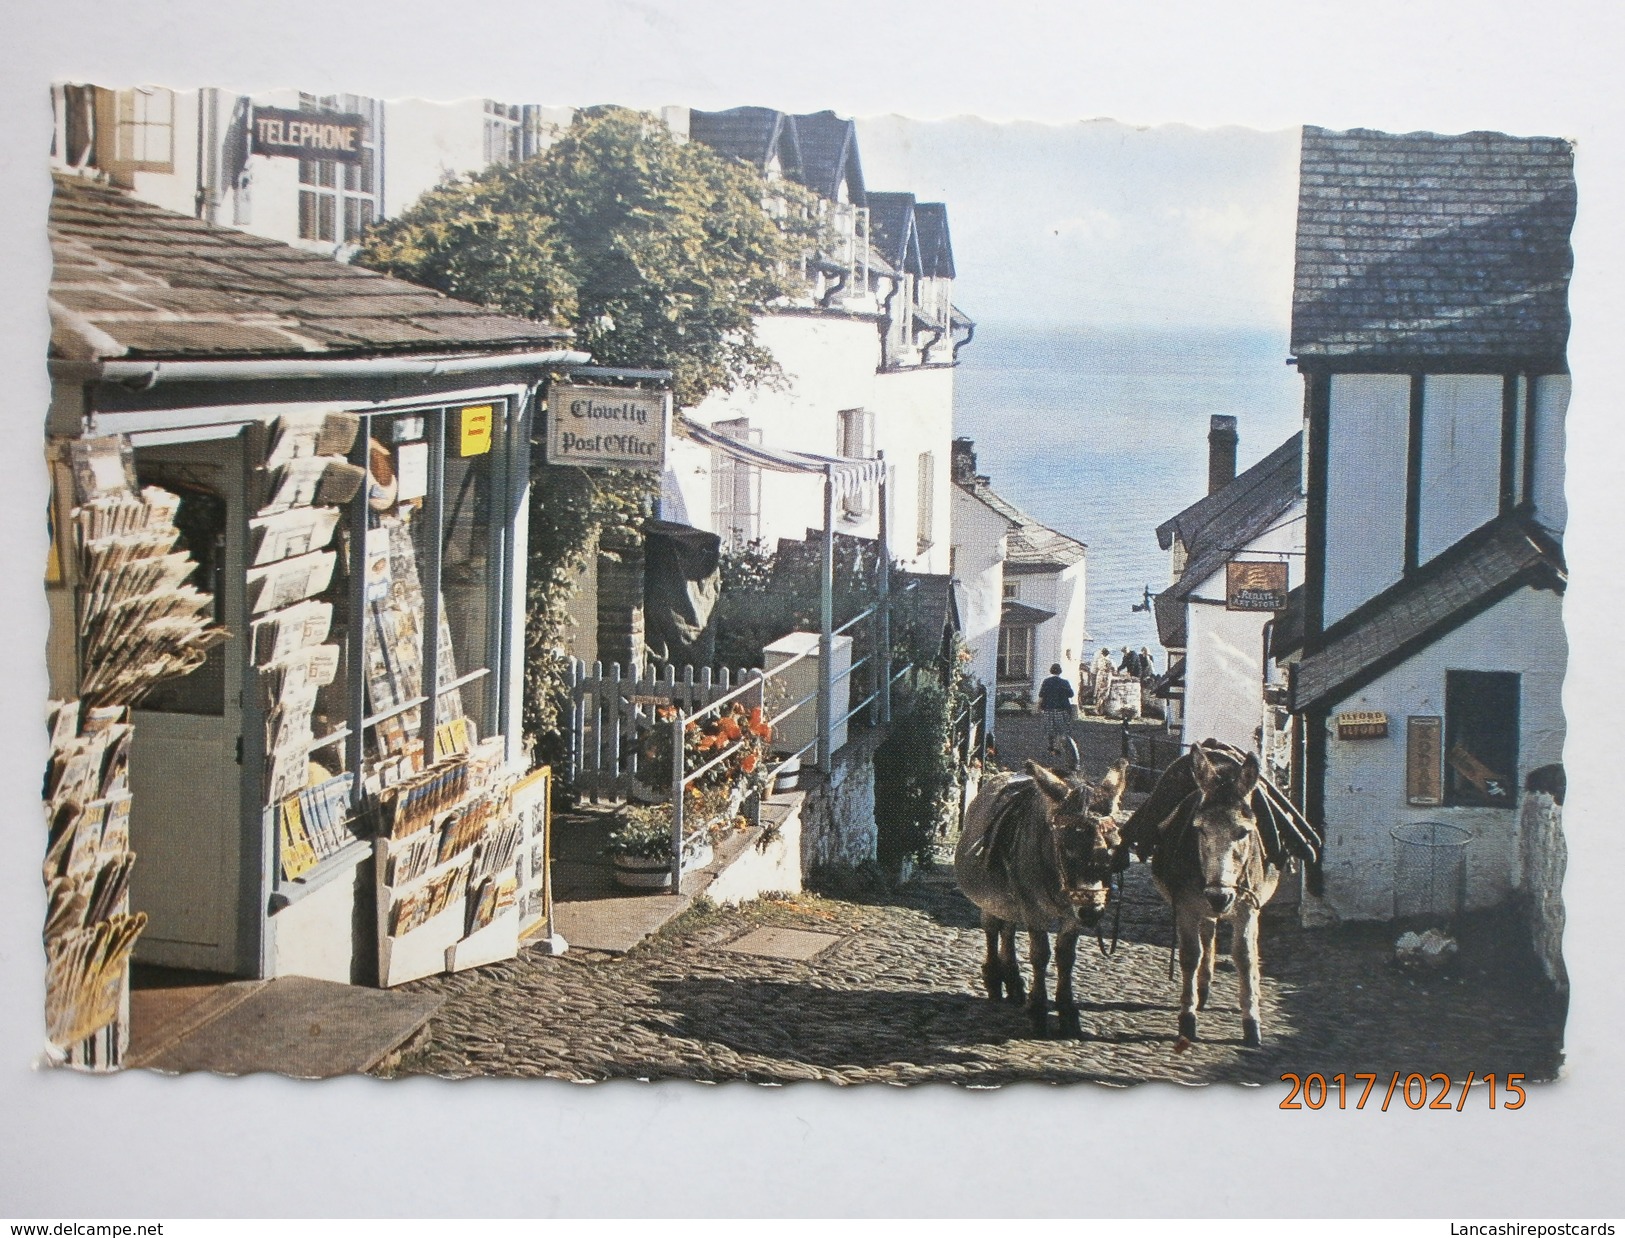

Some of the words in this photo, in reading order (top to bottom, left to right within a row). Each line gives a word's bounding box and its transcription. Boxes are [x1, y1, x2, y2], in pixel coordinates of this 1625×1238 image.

[257, 119, 358, 152] TELEPHONE
[571, 400, 647, 425] Clovelly
[563, 432, 602, 453] Post
[604, 434, 657, 455] Office
[1341, 711, 1382, 721] ILFORD
[1342, 724, 1384, 736] ILFORD
